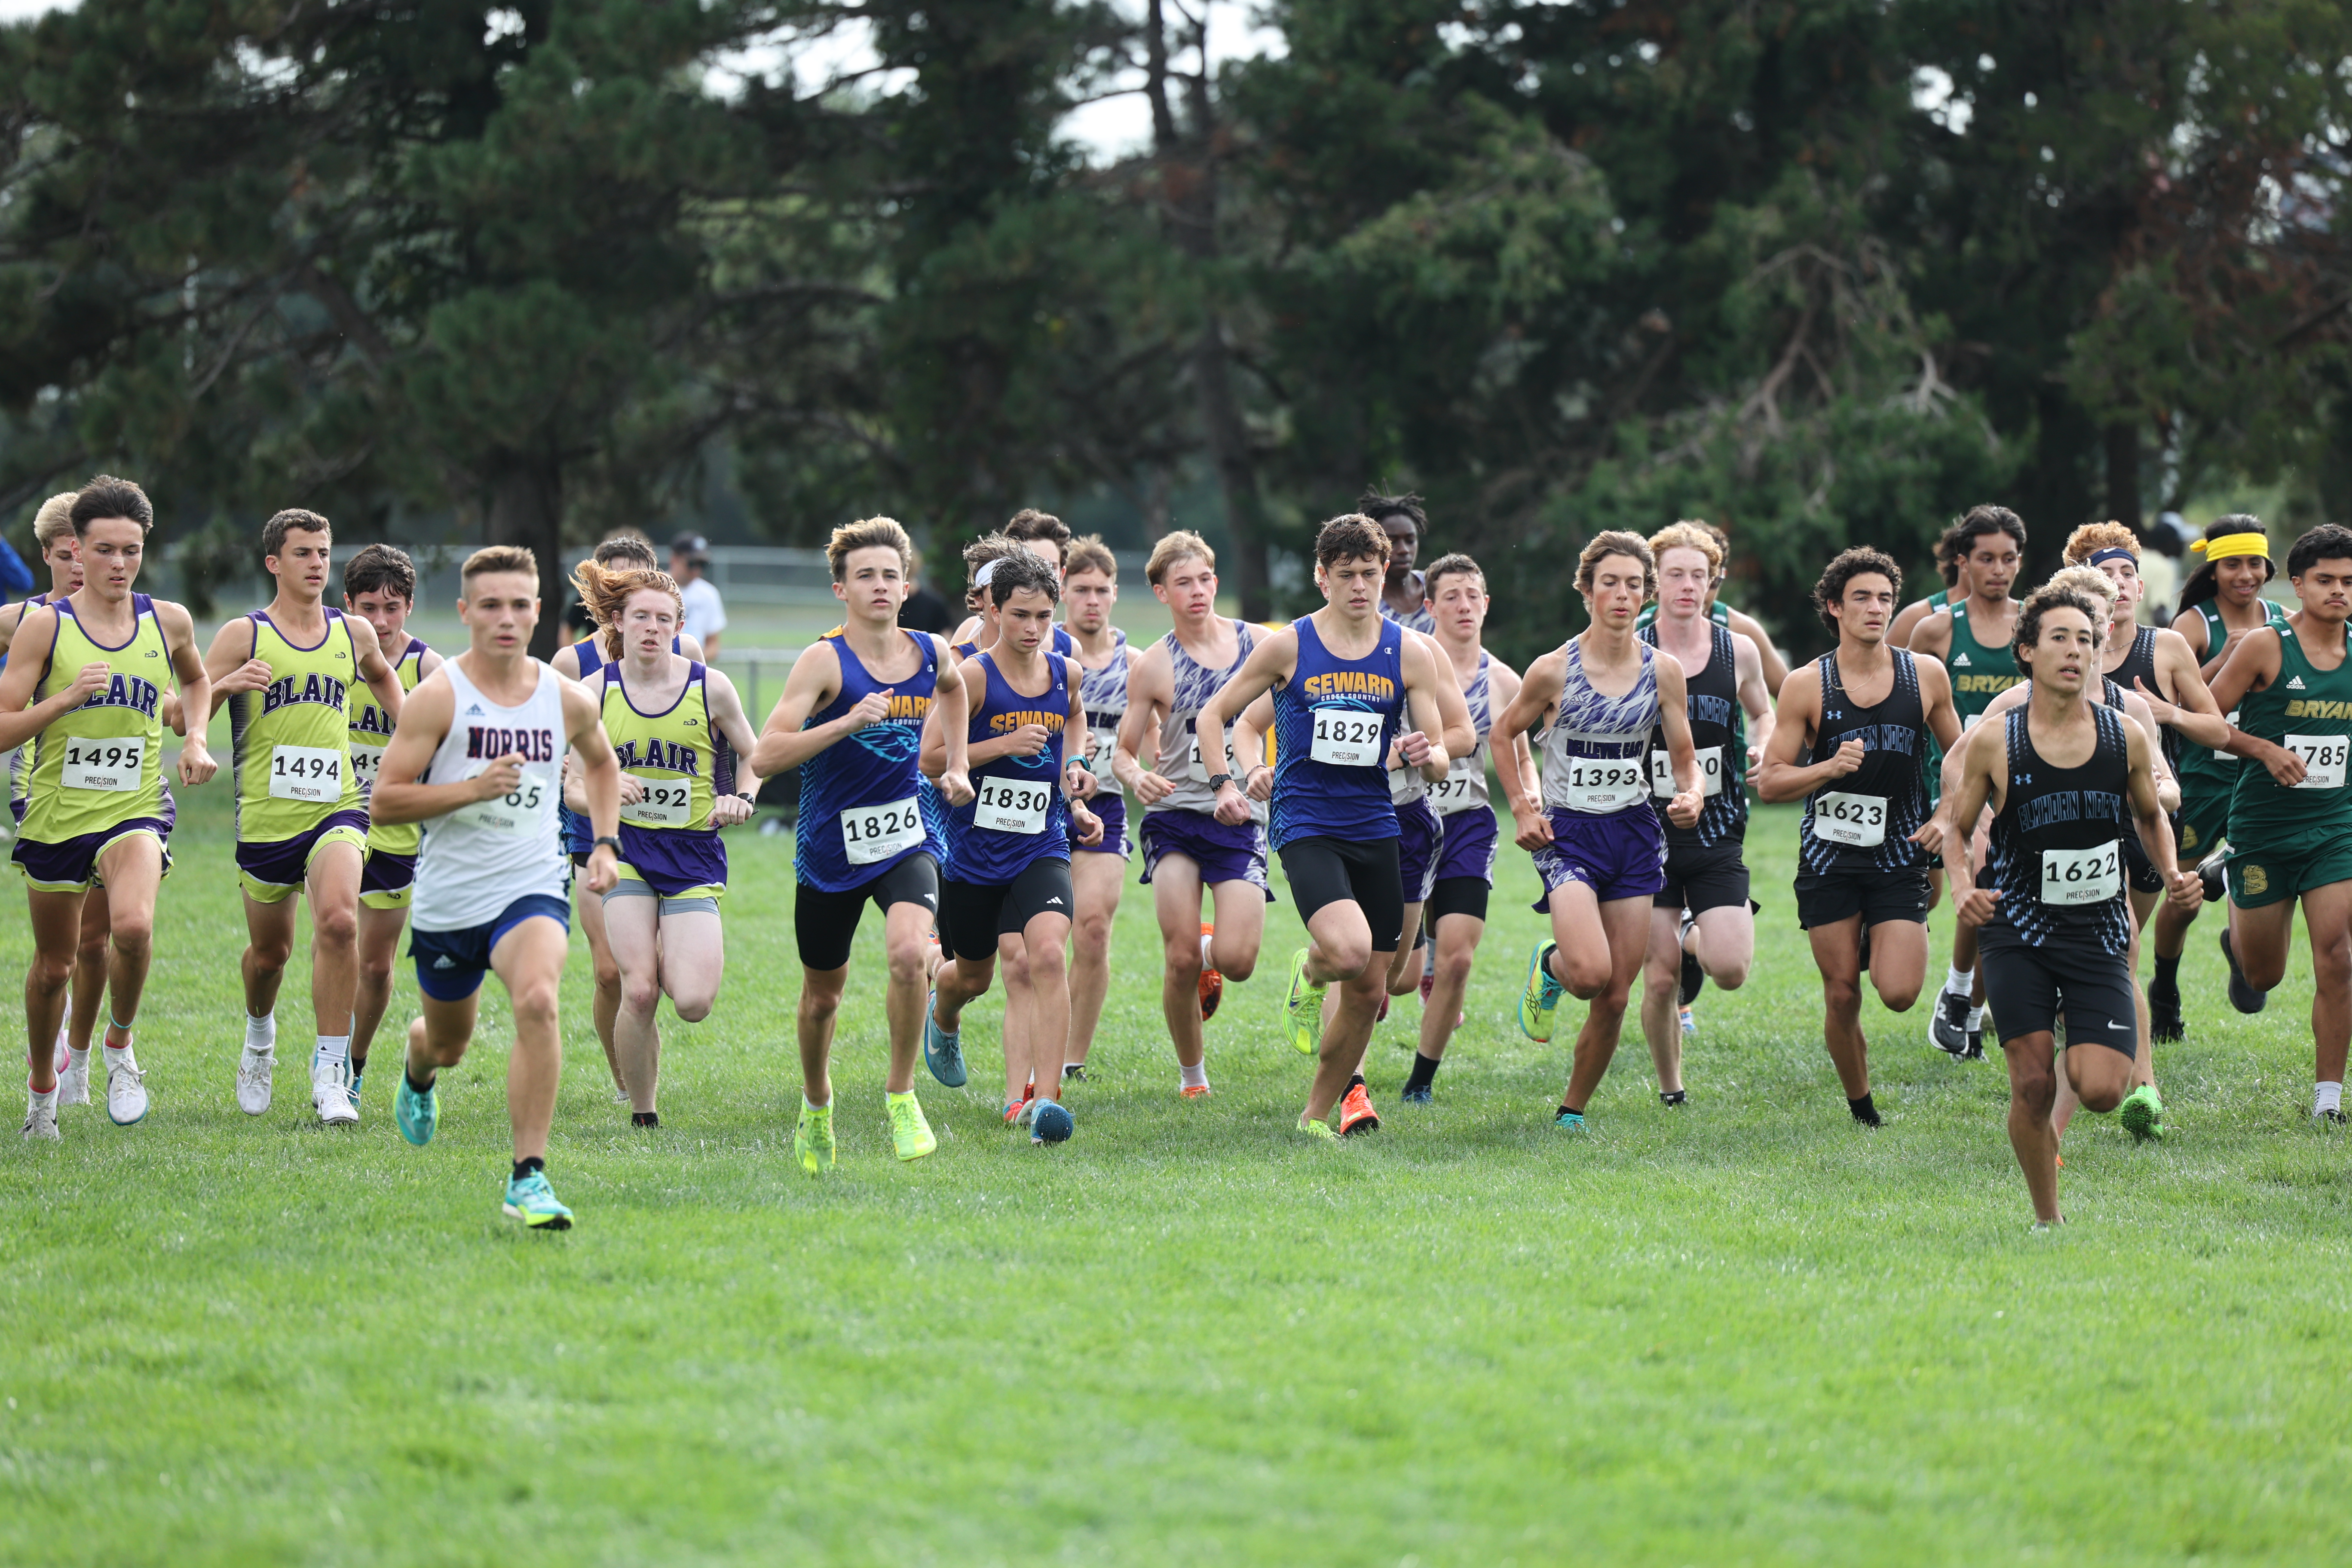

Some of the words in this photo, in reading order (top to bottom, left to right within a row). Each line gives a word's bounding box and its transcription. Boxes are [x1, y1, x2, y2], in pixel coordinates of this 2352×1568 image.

[62, 673, 159, 722] LAIR
[261, 673, 346, 719] BLAIR
[1304, 671, 1394, 703] SEWARD
[1321, 693, 1345, 701] CROSS
[1348, 693, 1380, 703] COUNTRY
[989, 710, 1065, 735] SEWARD
[1316, 719, 1379, 744] 1829
[467, 726, 552, 762] NORRIS
[1566, 738, 1622, 760] BELLEVUE
[1622, 739, 1645, 759] EAST
[67, 747, 140, 769] 1495
[614, 737, 699, 778] BLAIR
[1332, 750, 1360, 761] PRECISION
[274, 755, 339, 781] 1494
[1572, 768, 1638, 787] 1393
[1654, 757, 1718, 778] 10
[85, 775, 118, 787] PRECISION
[291, 786, 321, 797] PRECISION
[1426, 779, 1467, 797] 397
[642, 787, 687, 807] 492
[981, 786, 1047, 812] 1830
[1587, 793, 1616, 803] PRECISION
[638, 810, 668, 821] PRECISION
[995, 817, 1026, 828] PRECISION
[1817, 800, 1882, 826] 1623
[2017, 790, 2079, 833] ELKHORN
[845, 806, 916, 842] 1826
[1833, 828, 1862, 841] PRECISION
[869, 842, 903, 856] PRECISION
[2046, 851, 2116, 883] 1622
[2066, 888, 2100, 900] PRECISION
